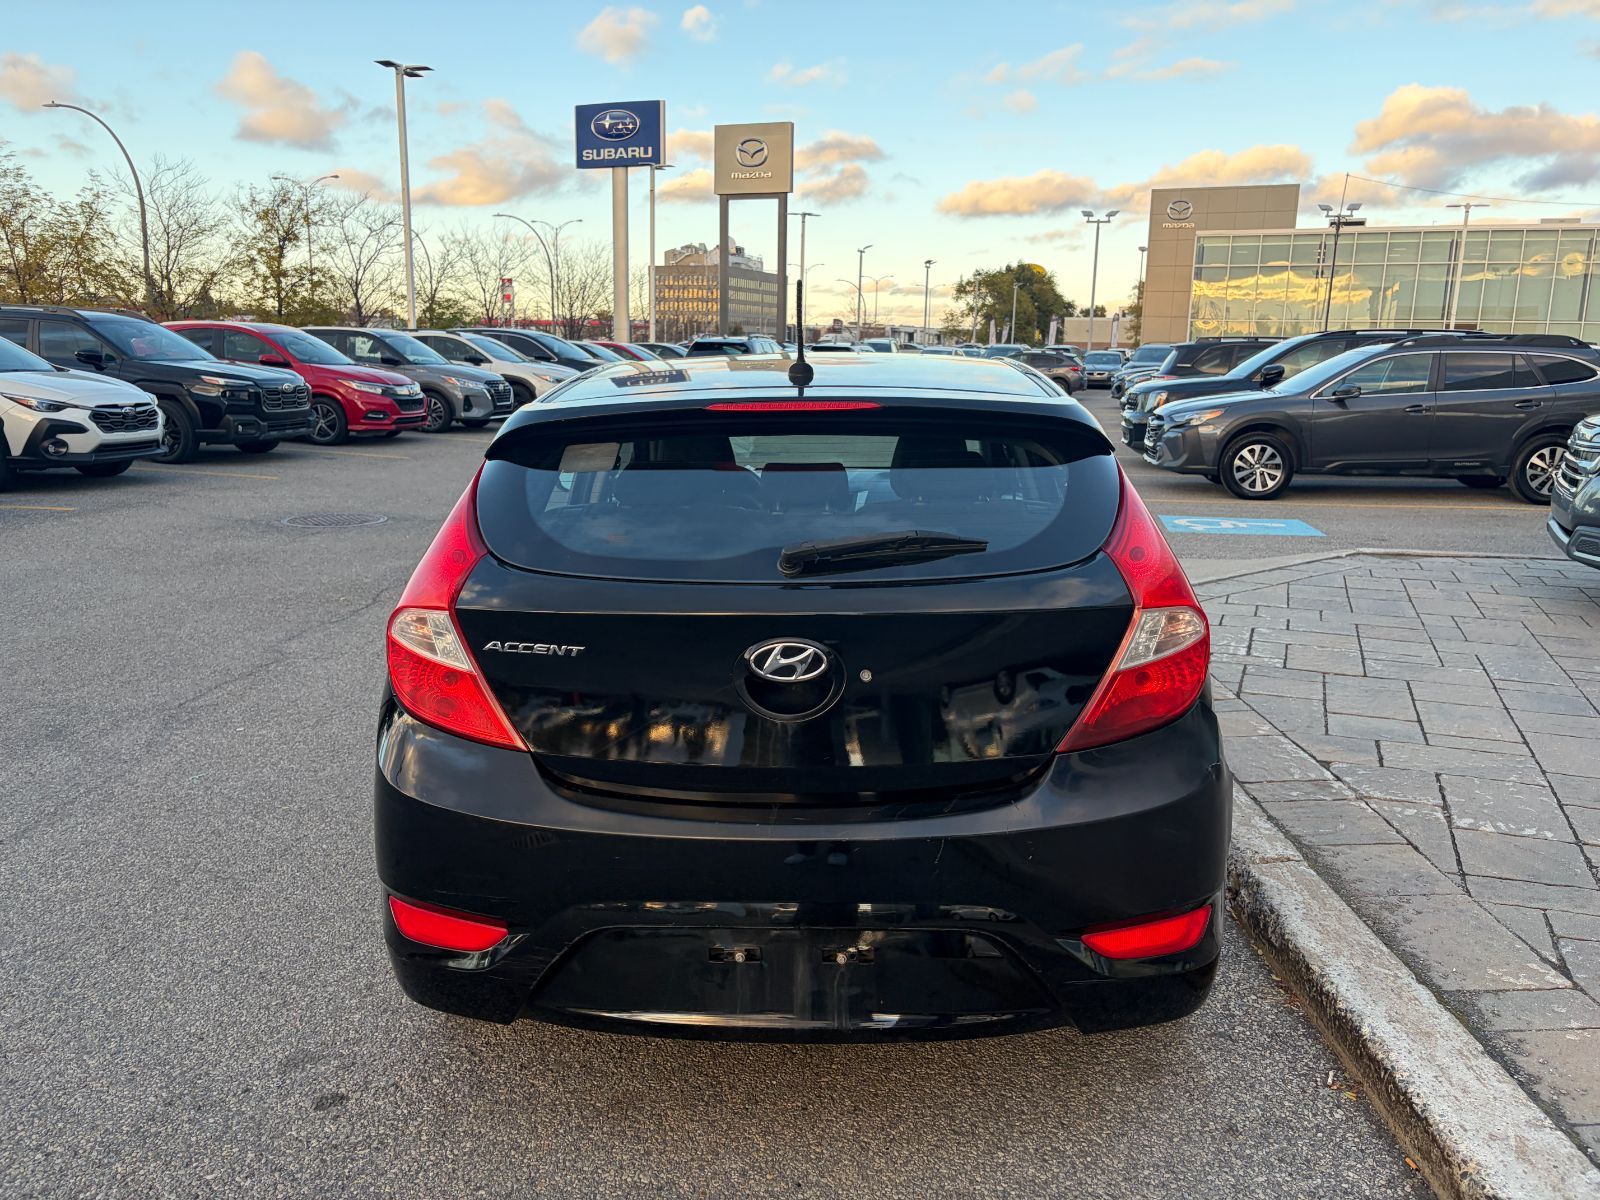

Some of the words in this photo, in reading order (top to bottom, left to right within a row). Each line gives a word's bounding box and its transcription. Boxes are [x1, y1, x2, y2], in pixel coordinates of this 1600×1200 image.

[582, 147, 653, 161] SUBARU
[731, 171, 772, 180] mazda
[482, 640, 586, 657] ACCENT
